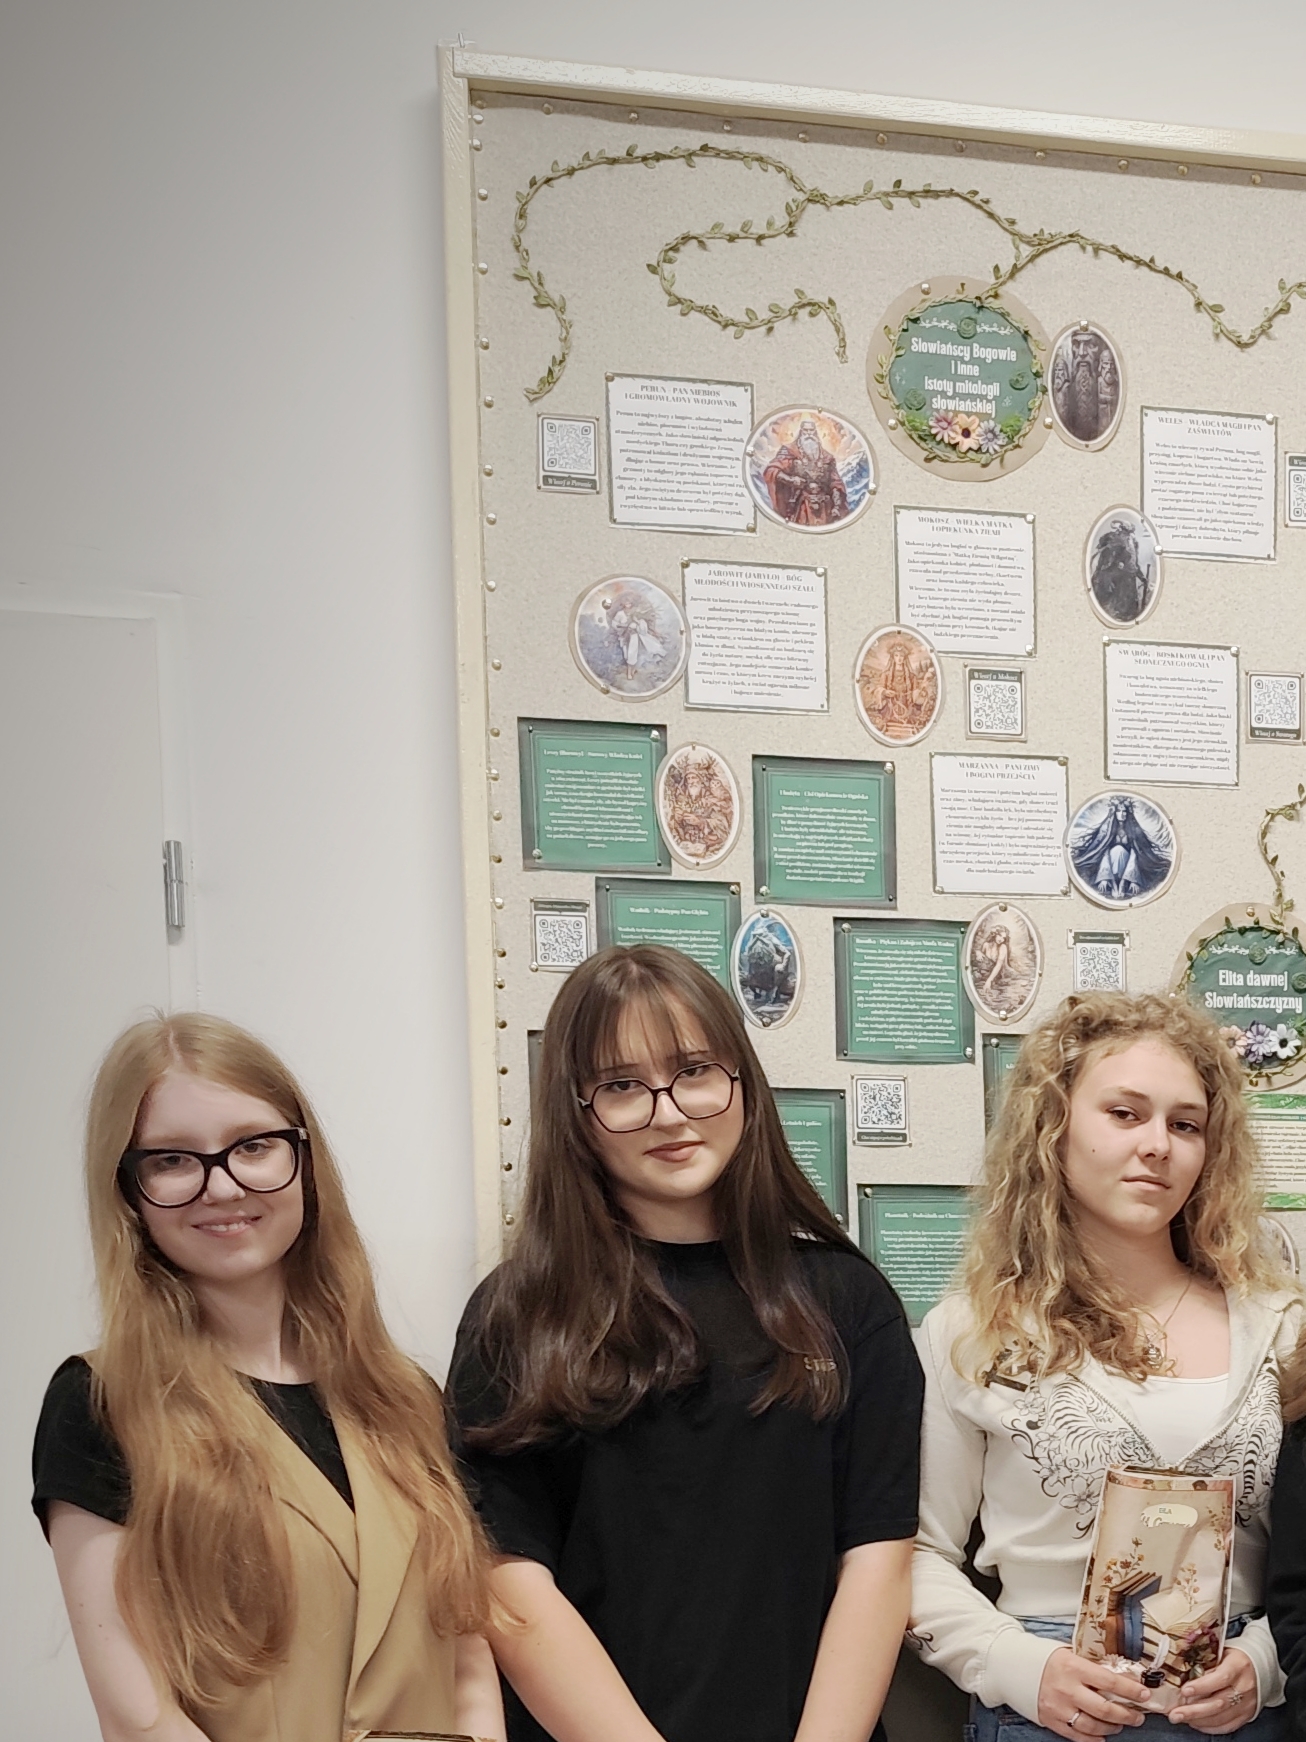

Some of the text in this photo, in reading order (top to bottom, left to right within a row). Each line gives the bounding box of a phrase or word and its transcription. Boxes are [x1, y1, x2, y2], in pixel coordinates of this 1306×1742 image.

[973, 343, 1017, 363] Bogowie
[957, 361, 979, 376] inne
[925, 376, 1000, 399] istoty mitologii
[1219, 970, 1288, 991] Elita dawnej
